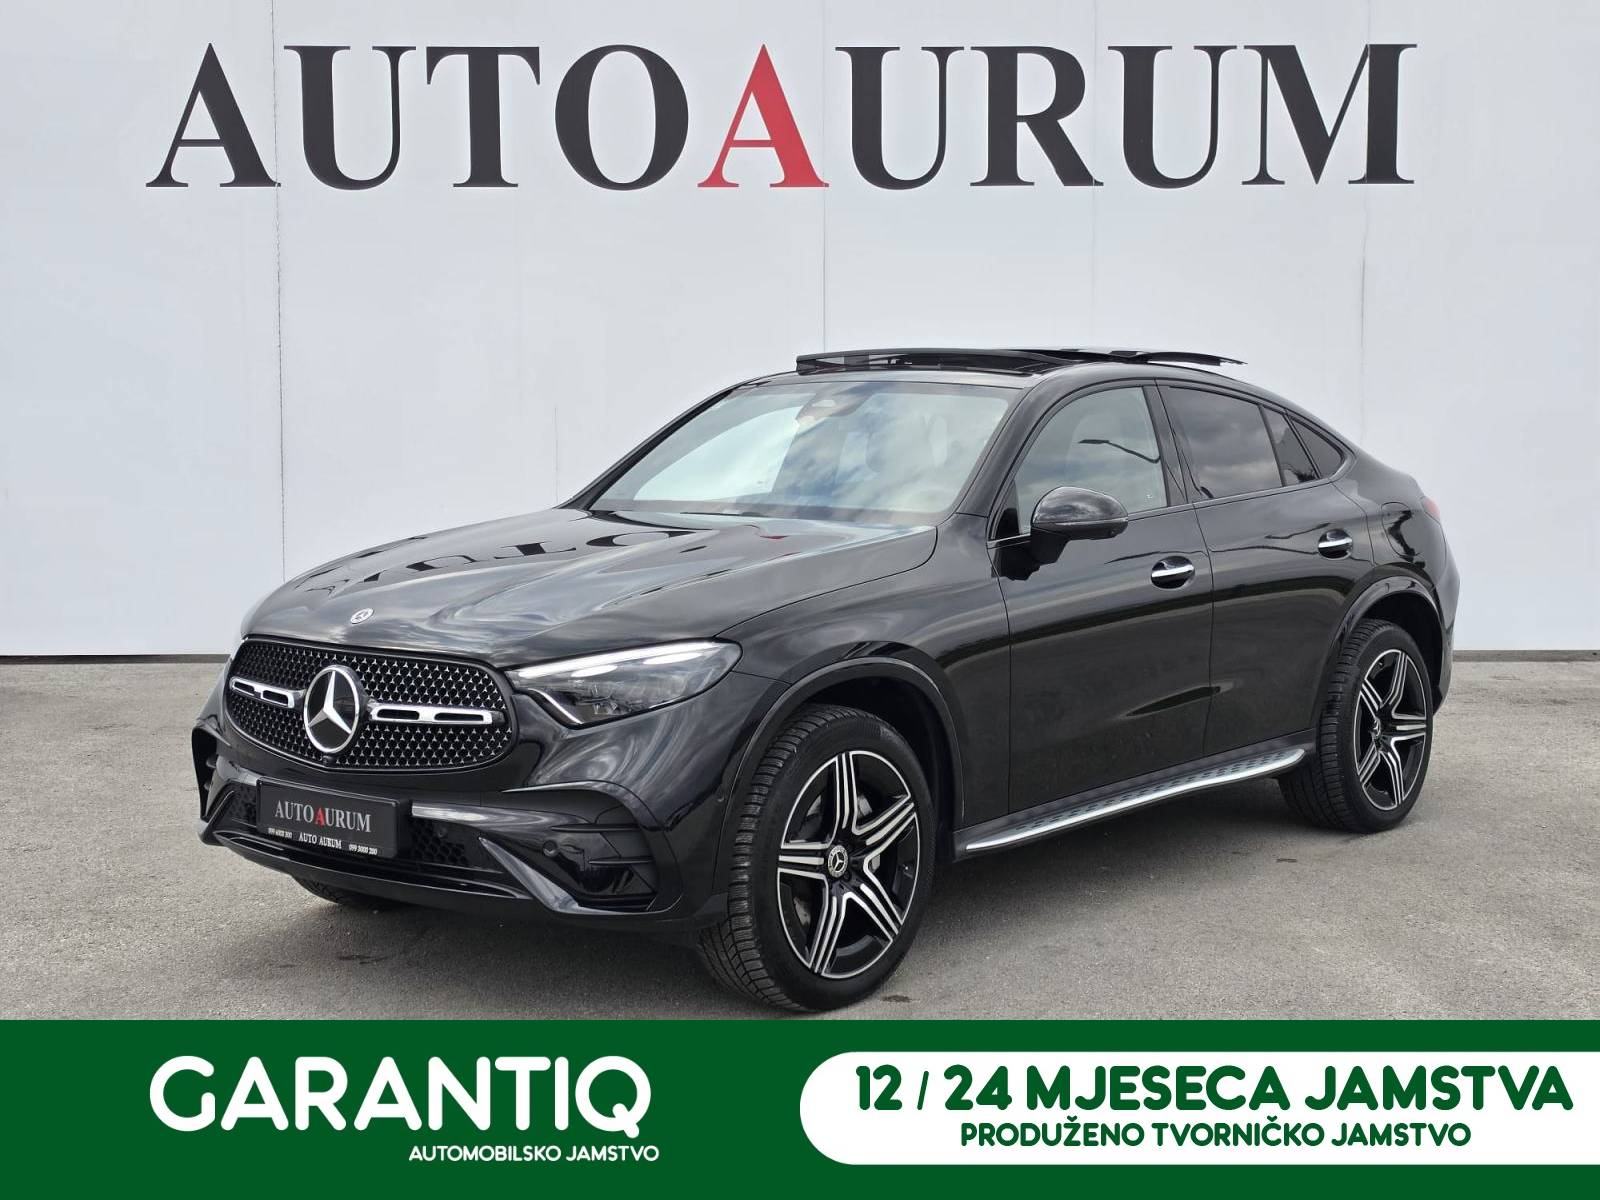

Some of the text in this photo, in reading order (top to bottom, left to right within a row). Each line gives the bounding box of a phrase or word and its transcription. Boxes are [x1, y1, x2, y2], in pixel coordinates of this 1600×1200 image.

[146, 42, 1417, 191] AUTOAURUM
[274, 799, 372, 833] AUTOAURUM
[298, 832, 318, 844] AUTO
